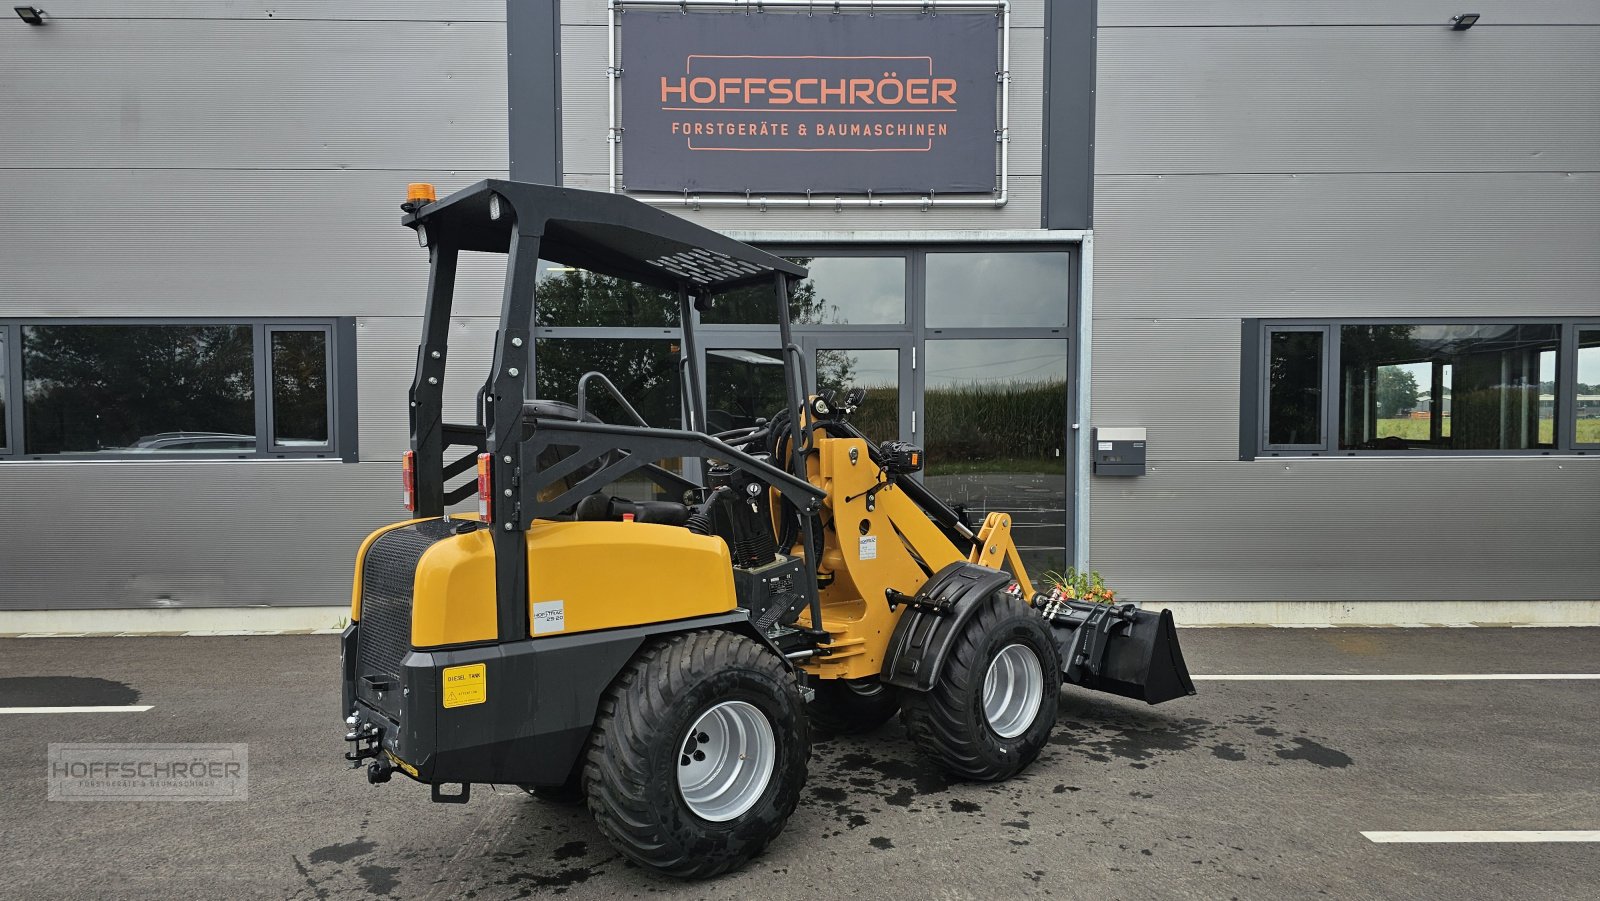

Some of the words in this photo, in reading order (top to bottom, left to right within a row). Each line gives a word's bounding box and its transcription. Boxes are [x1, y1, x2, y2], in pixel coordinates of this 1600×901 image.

[660, 71, 957, 104] HOFFSCHRÖER
[672, 121, 789, 136] FORSTGERÄTE
[798, 124, 807, 135] &
[817, 123, 948, 136] BAUMASCHINEN
[447, 674, 466, 682] DIESEL
